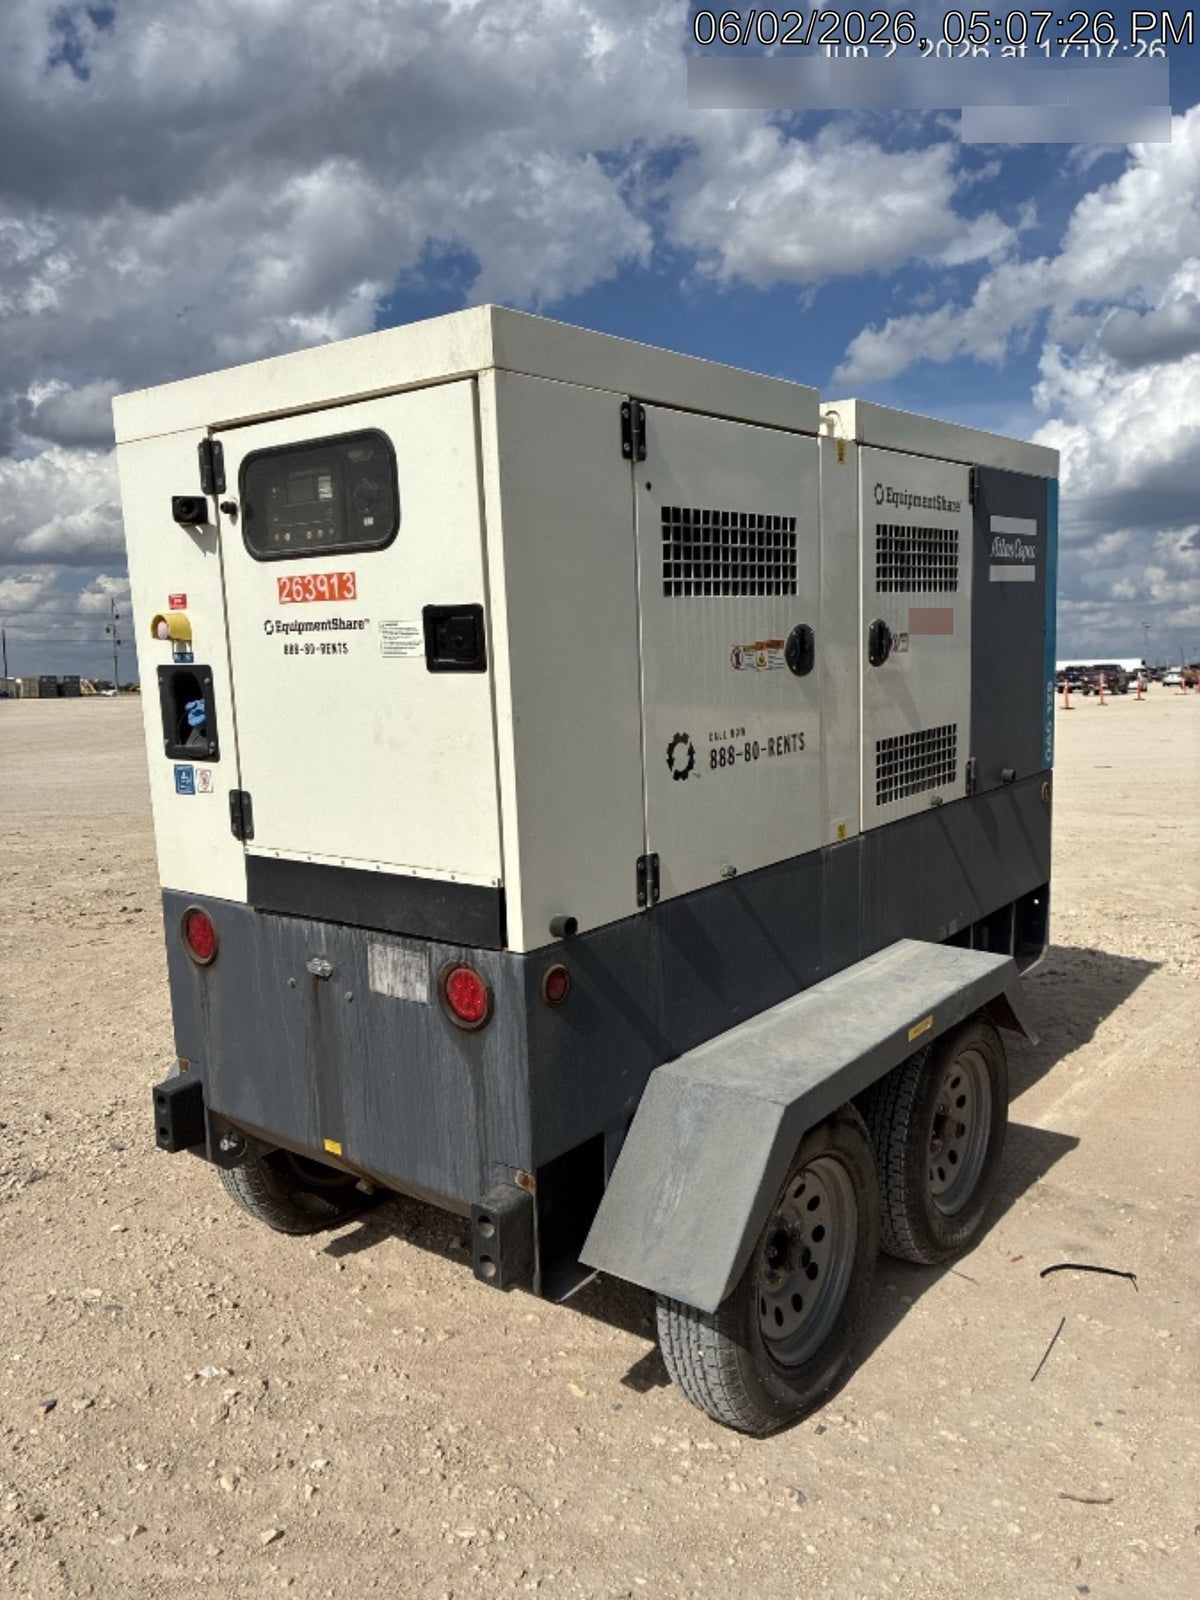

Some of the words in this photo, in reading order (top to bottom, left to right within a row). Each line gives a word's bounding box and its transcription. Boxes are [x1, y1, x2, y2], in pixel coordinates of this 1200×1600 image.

[886, 487, 961, 512] EquipmentShare
[990, 536, 1014, 558] Atlas
[279, 572, 356, 602] 263913
[275, 618, 366, 635] EquipmentShare
[283, 642, 349, 656] 888-80-RENTS
[710, 732, 805, 770] 888-80-RENTS
